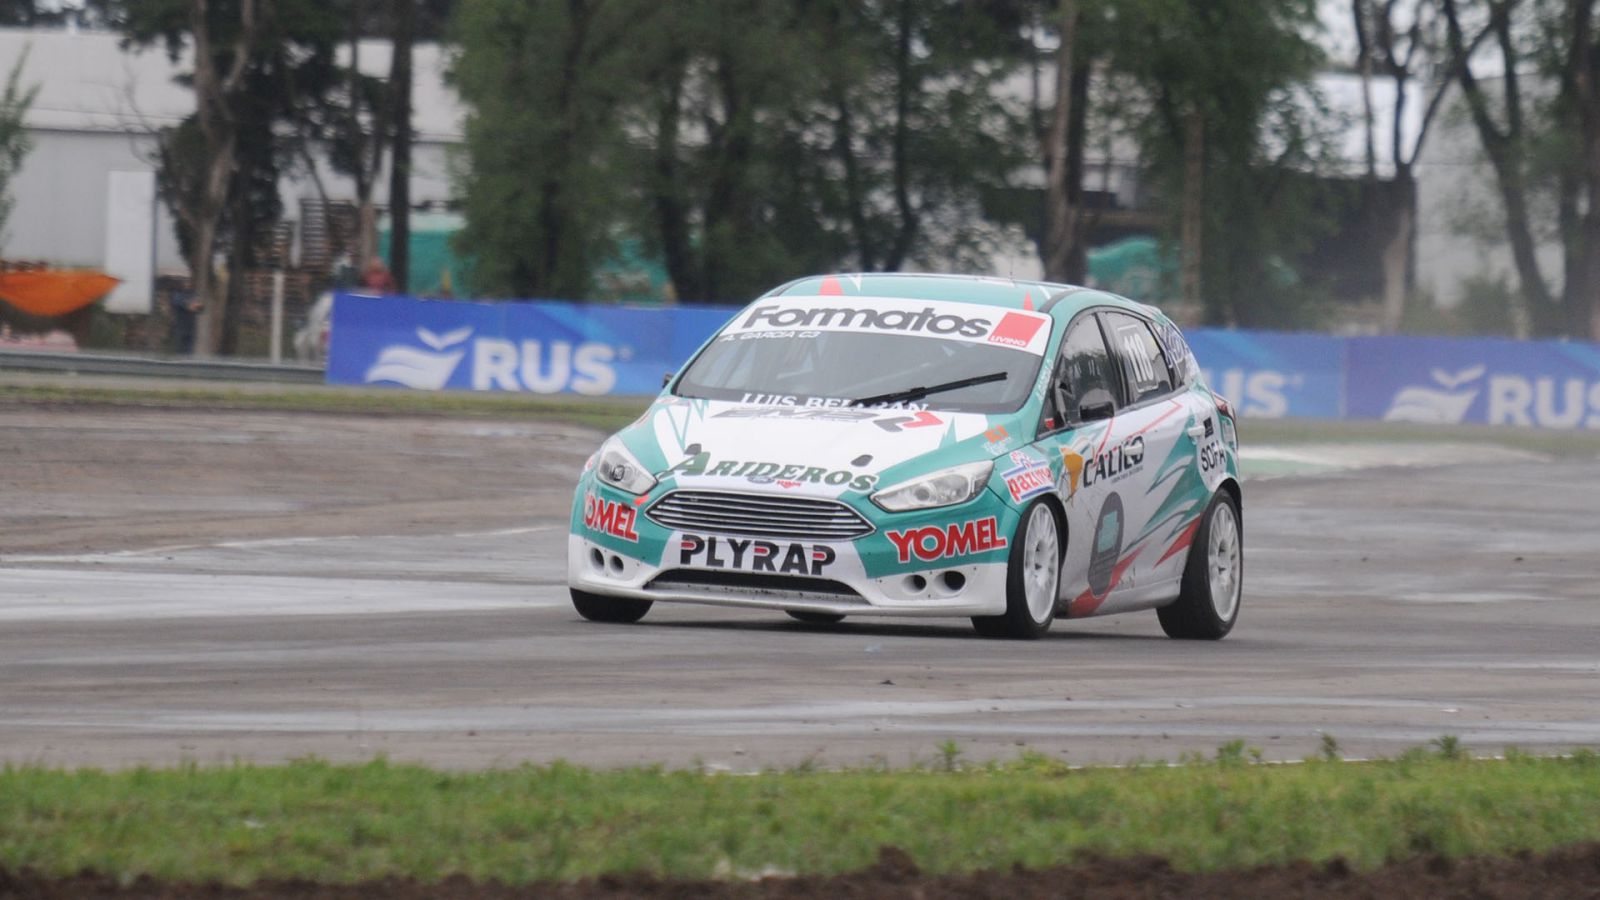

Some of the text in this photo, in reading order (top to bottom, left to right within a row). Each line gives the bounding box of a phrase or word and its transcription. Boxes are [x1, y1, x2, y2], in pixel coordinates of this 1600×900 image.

[740, 330, 795, 341] GARCIA
[742, 304, 992, 338] Formatos
[990, 334, 1027, 347] LIVING
[472, 337, 616, 396] RUS
[740, 393, 797, 407] LUIS
[1197, 369, 1287, 419] US
[1488, 375, 1600, 430] RU
[655, 452, 877, 491] ARIDEROS
[584, 494, 639, 543] OMEL
[885, 516, 1008, 563] YOMEL
[680, 533, 836, 576] PLYRAP
